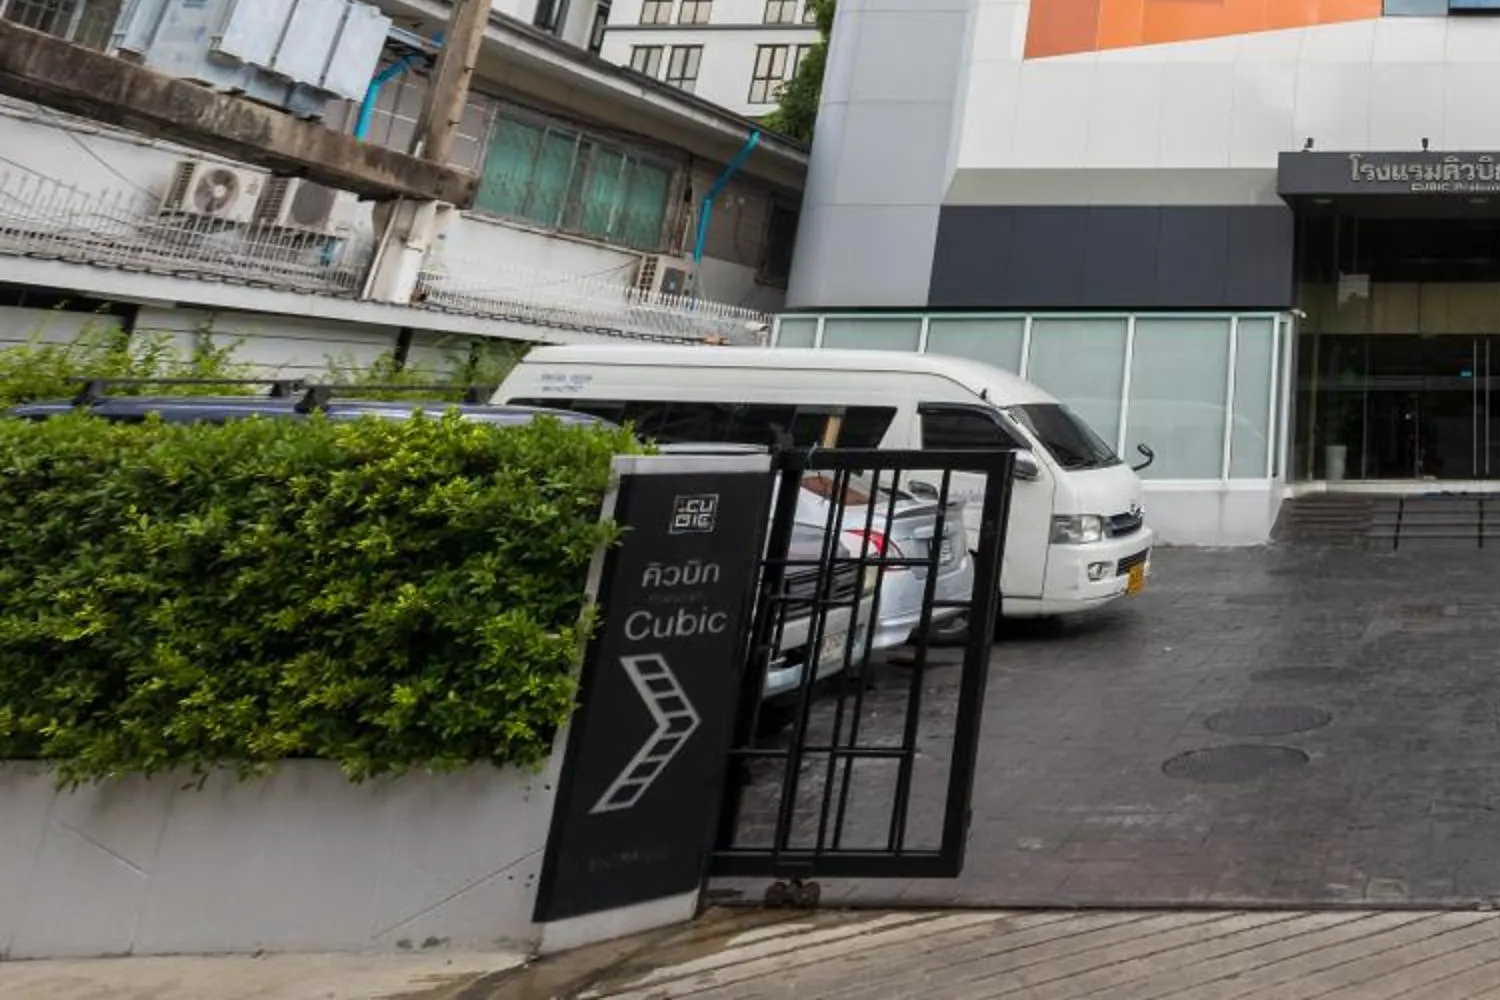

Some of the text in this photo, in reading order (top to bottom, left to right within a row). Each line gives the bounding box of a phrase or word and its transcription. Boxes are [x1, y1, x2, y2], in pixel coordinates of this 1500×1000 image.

[641, 559, 721, 588] คิวบิก
[623, 606, 728, 642] Cubic
